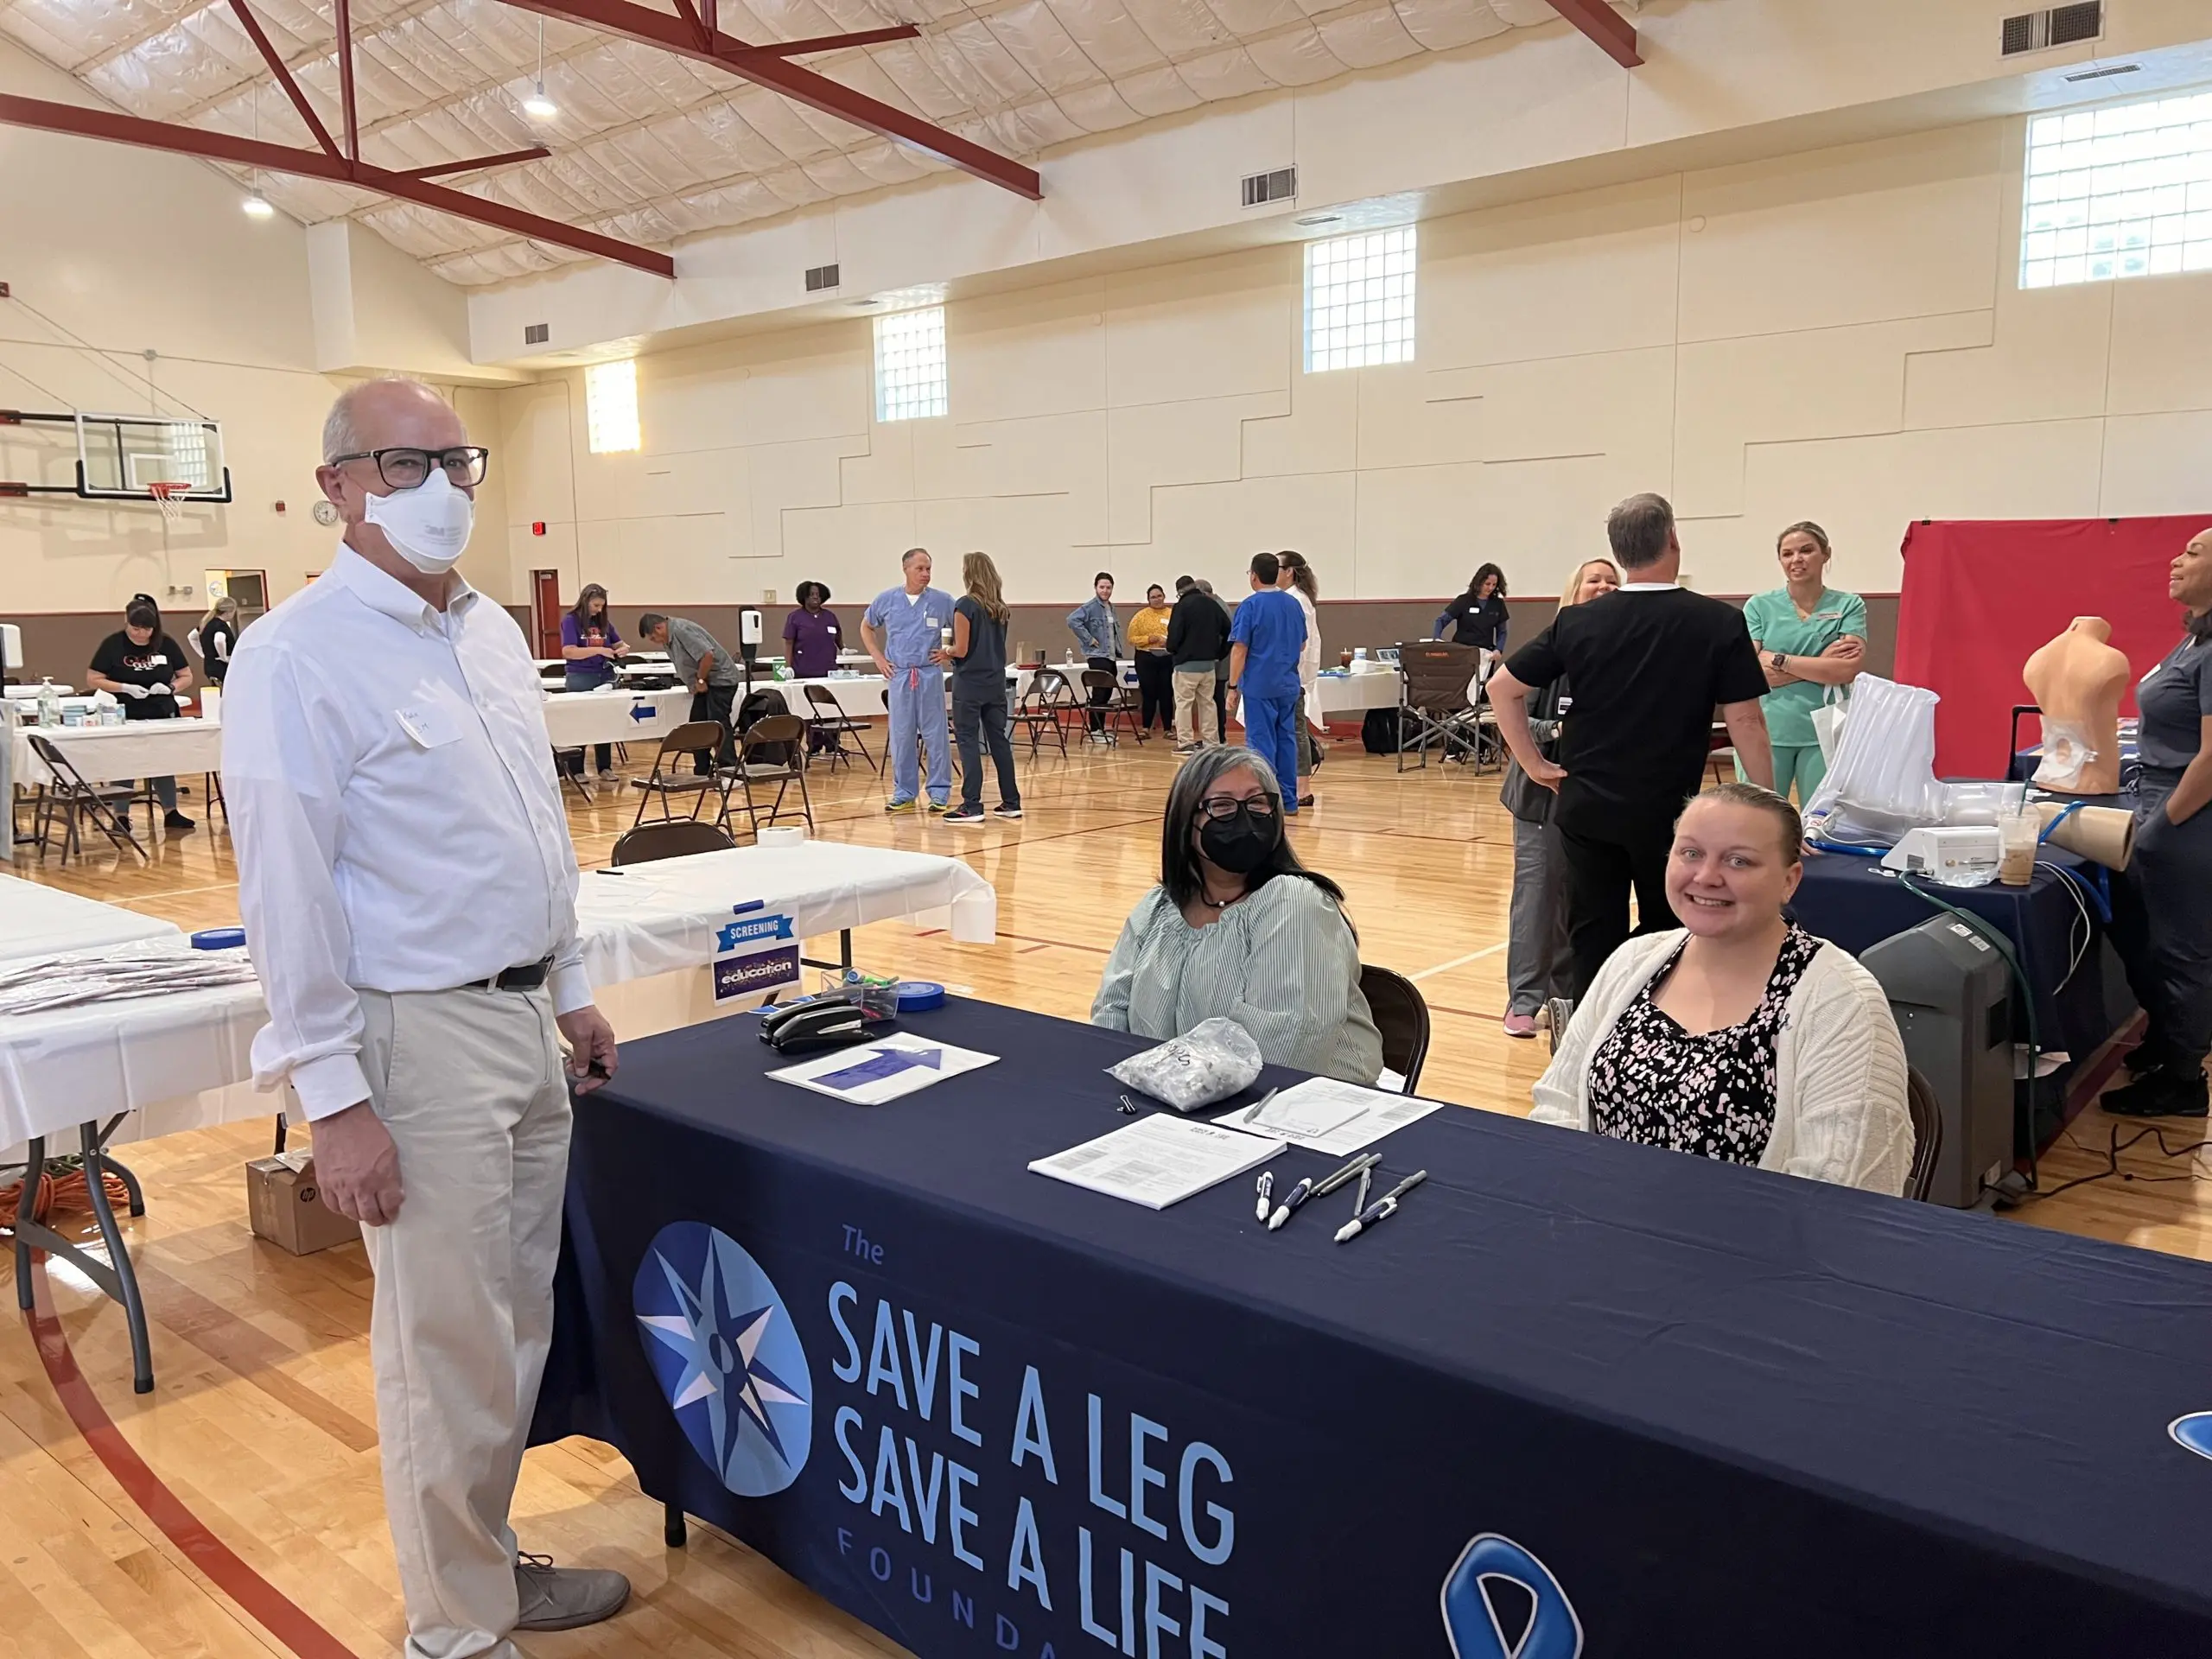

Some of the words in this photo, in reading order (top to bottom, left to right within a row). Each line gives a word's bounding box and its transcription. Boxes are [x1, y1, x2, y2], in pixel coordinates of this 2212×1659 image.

[730, 920, 779, 939] SCREENING
[721, 961, 791, 983] education
[842, 1224, 884, 1265] The
[829, 1281, 982, 1447] SAVE
[1011, 1364, 1058, 1485] A
[1088, 1393, 1234, 1566] LEG
[835, 1406, 983, 1572] SAVE
[1007, 1497, 1052, 1611] A
[1078, 1526, 1230, 1659] LIFE
